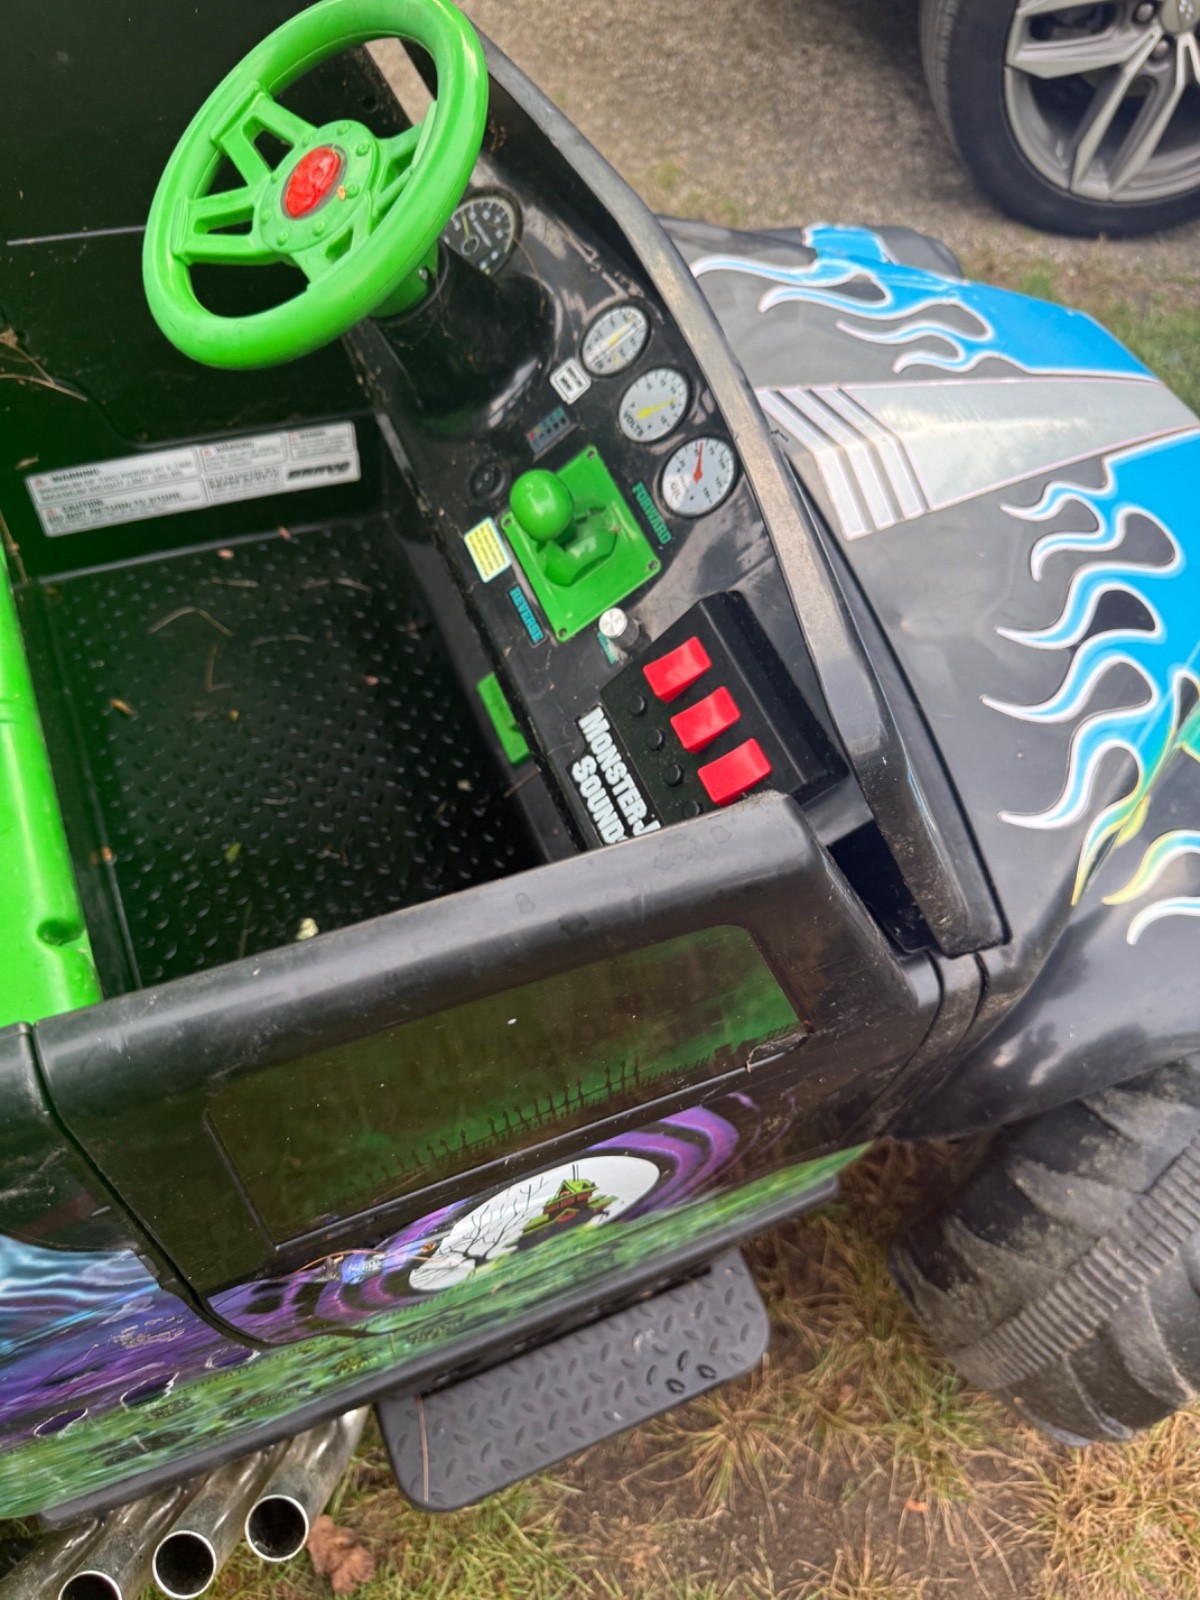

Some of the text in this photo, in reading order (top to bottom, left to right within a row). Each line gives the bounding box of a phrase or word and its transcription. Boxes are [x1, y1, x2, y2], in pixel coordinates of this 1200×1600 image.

[622, 411, 644, 438] VOLTS
[633, 482, 672, 545] FORWARD
[509, 586, 544, 644] REVERSE
[578, 707, 647, 826] MONSTER
[571, 755, 628, 845] SOUND
